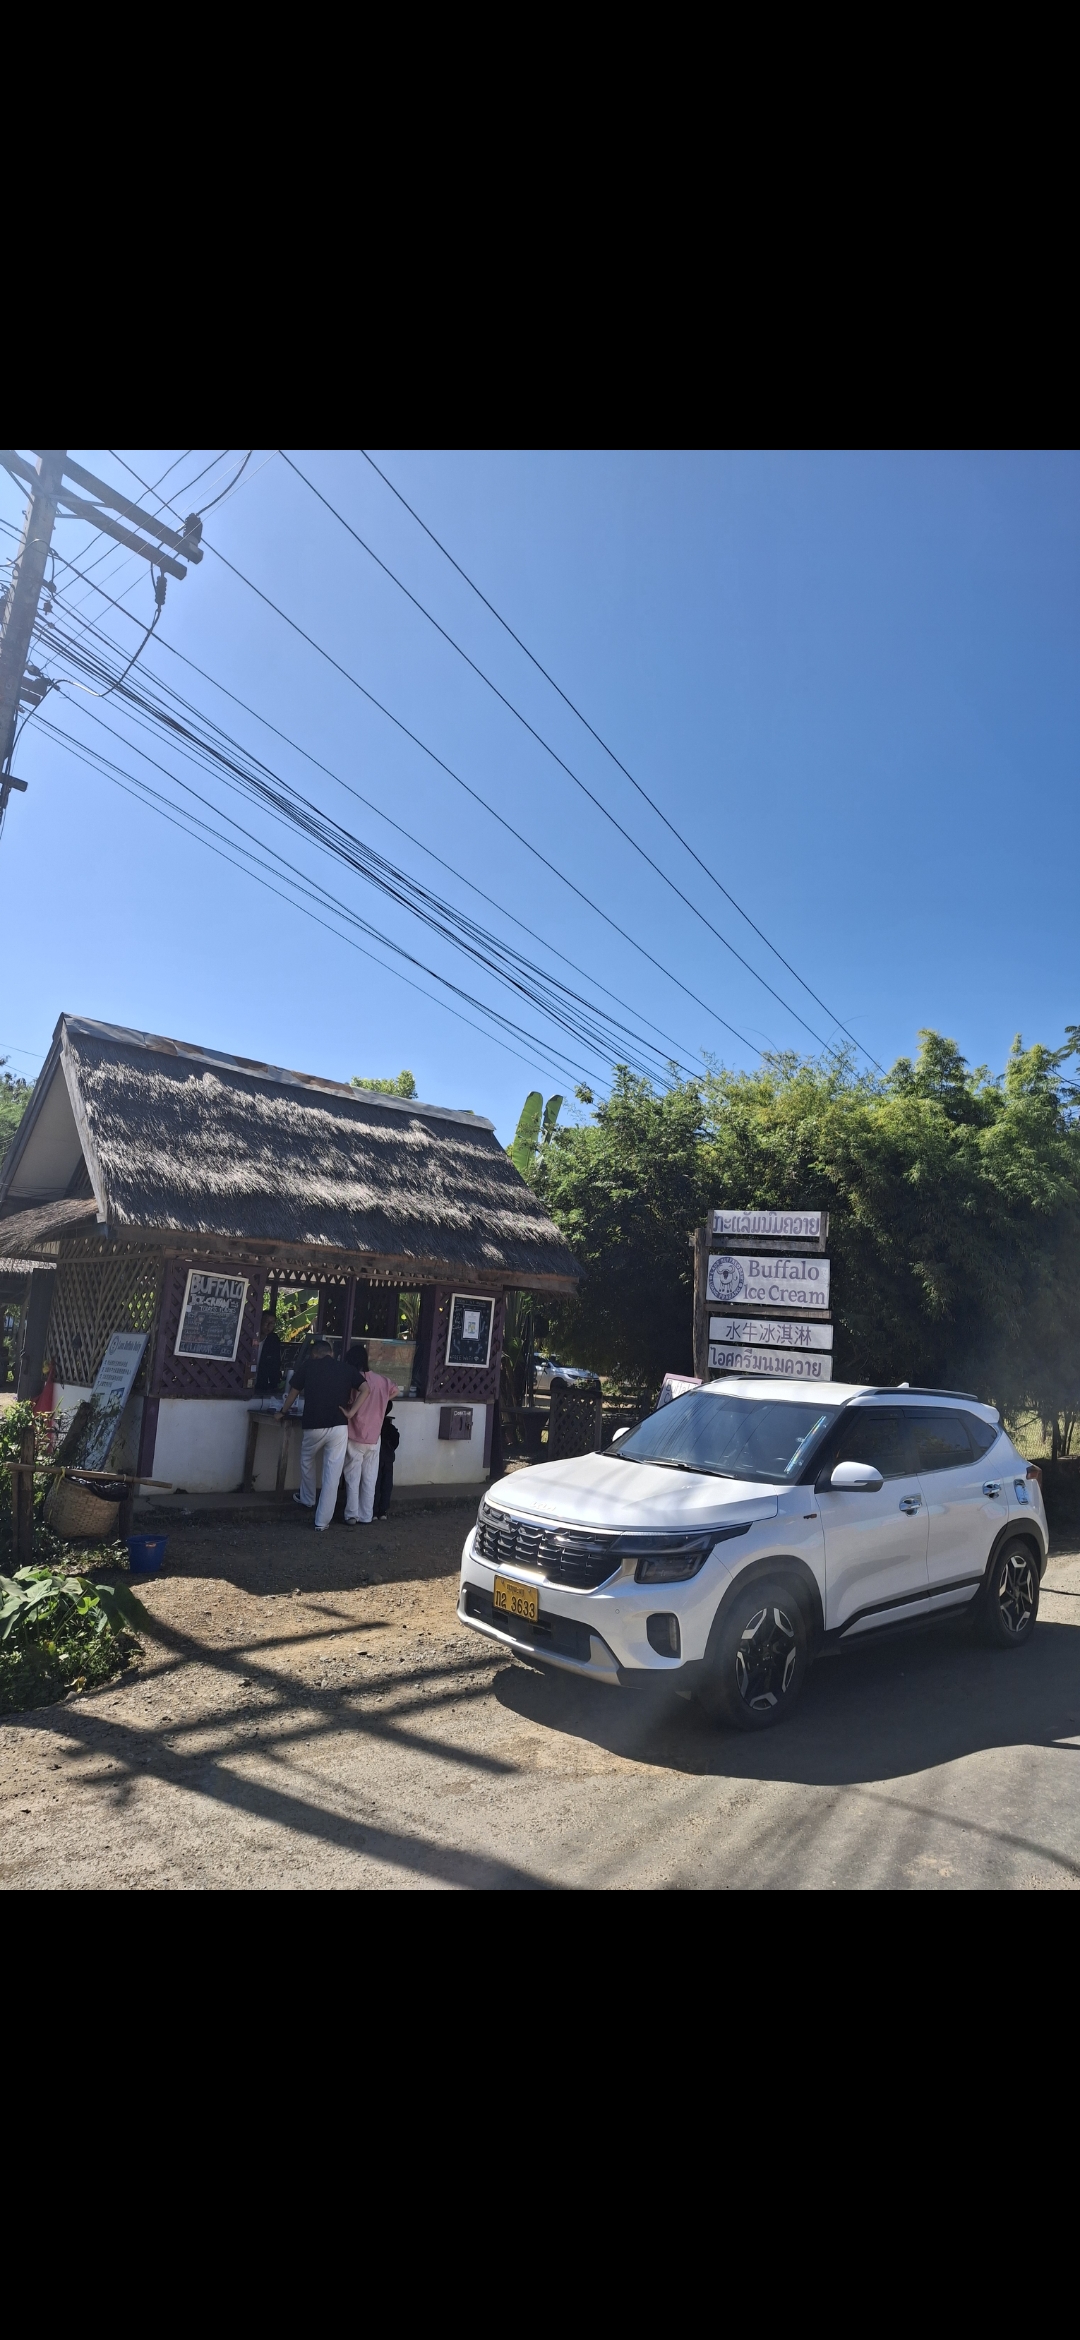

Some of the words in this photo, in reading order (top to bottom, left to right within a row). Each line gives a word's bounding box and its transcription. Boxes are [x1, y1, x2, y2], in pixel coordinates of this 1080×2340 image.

[748, 1260, 820, 1281] Buffalo
[191, 1274, 244, 1300] BUFFALO
[743, 1284, 766, 1300] Ice
[768, 1285, 825, 1305] Cream
[725, 1321, 812, 1346] 水牛冰淇淋
[511, 1595, 535, 1618] 3633
